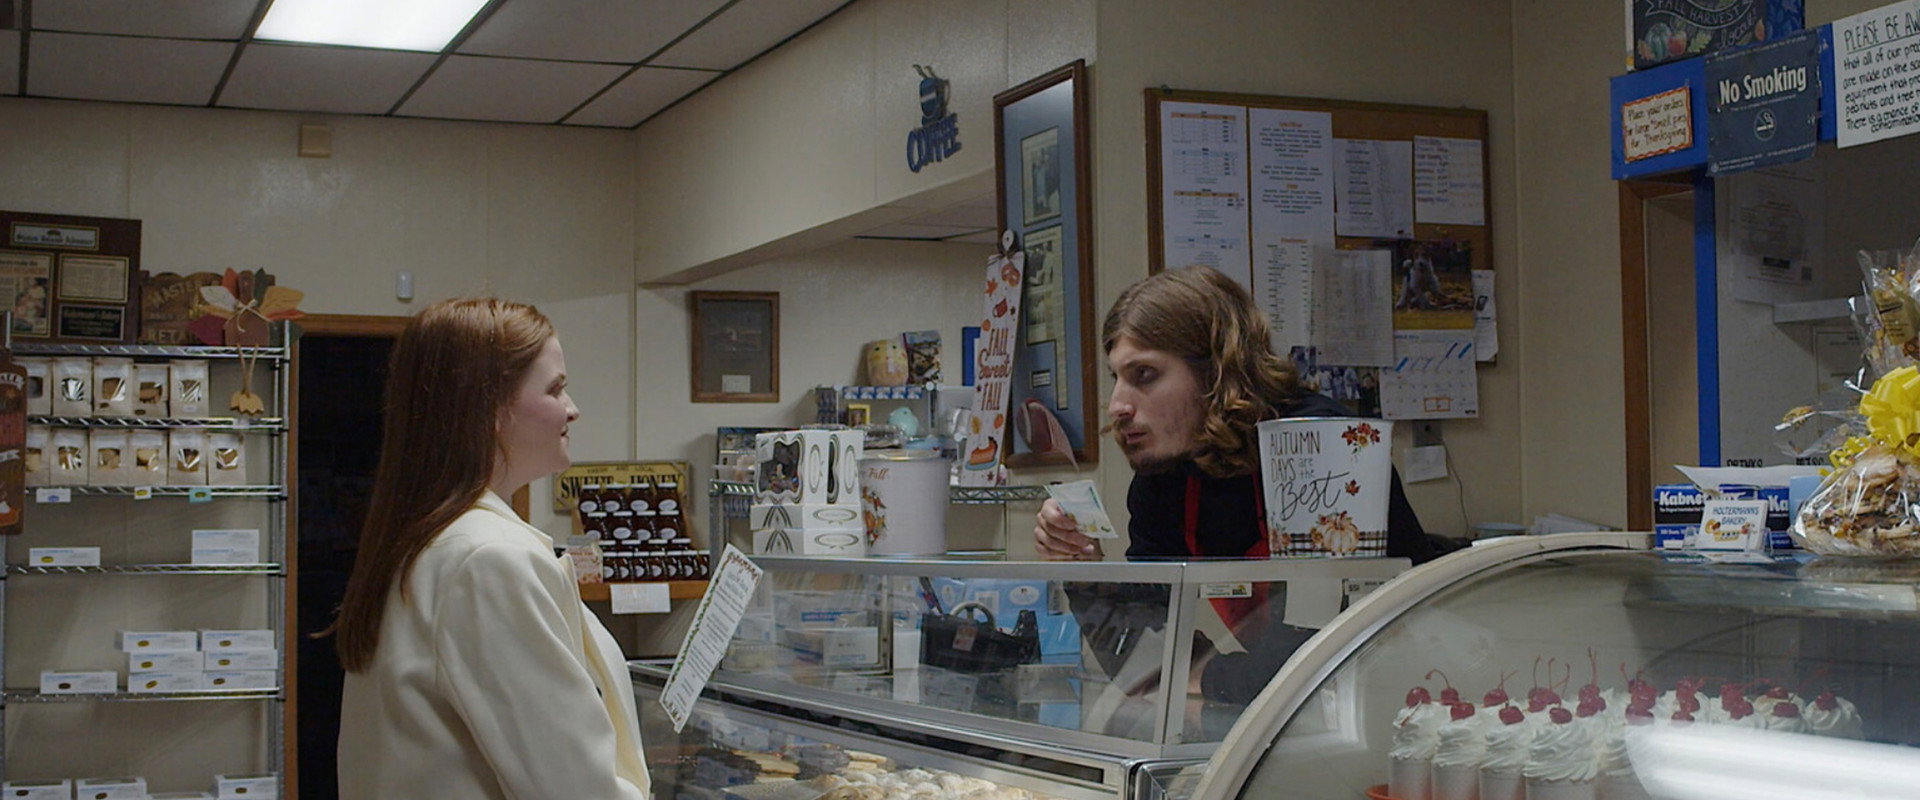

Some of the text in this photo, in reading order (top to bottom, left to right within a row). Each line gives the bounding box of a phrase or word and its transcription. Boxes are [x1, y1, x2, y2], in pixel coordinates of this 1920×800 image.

[1690, 6, 1740, 24] HARVEST
[1844, 20, 1879, 50] PLEASE
[1885, 15, 1899, 39] BE
[1844, 56, 1860, 71] that
[1863, 50, 1872, 66] all
[1875, 48, 1884, 64] of
[1887, 46, 1902, 60] our
[1720, 79, 1740, 105] No
[1743, 65, 1807, 99] Smoking
[1843, 76, 1857, 90] are
[1882, 66, 1894, 79] on
[1845, 82, 1887, 104] equipment
[1890, 78, 1907, 90] that
[1846, 100, 1879, 117] peanuts
[1880, 95, 1895, 108] and
[1897, 90, 1914, 103] tree
[1846, 117, 1866, 131] There
[1869, 114, 1876, 124] is
[907, 113, 961, 173] COFFEE
[1270, 431, 1321, 456] AUTUMN
[1271, 457, 1297, 483] DAYS
[1300, 468, 1315, 480] the
[1275, 470, 1350, 521] Best
